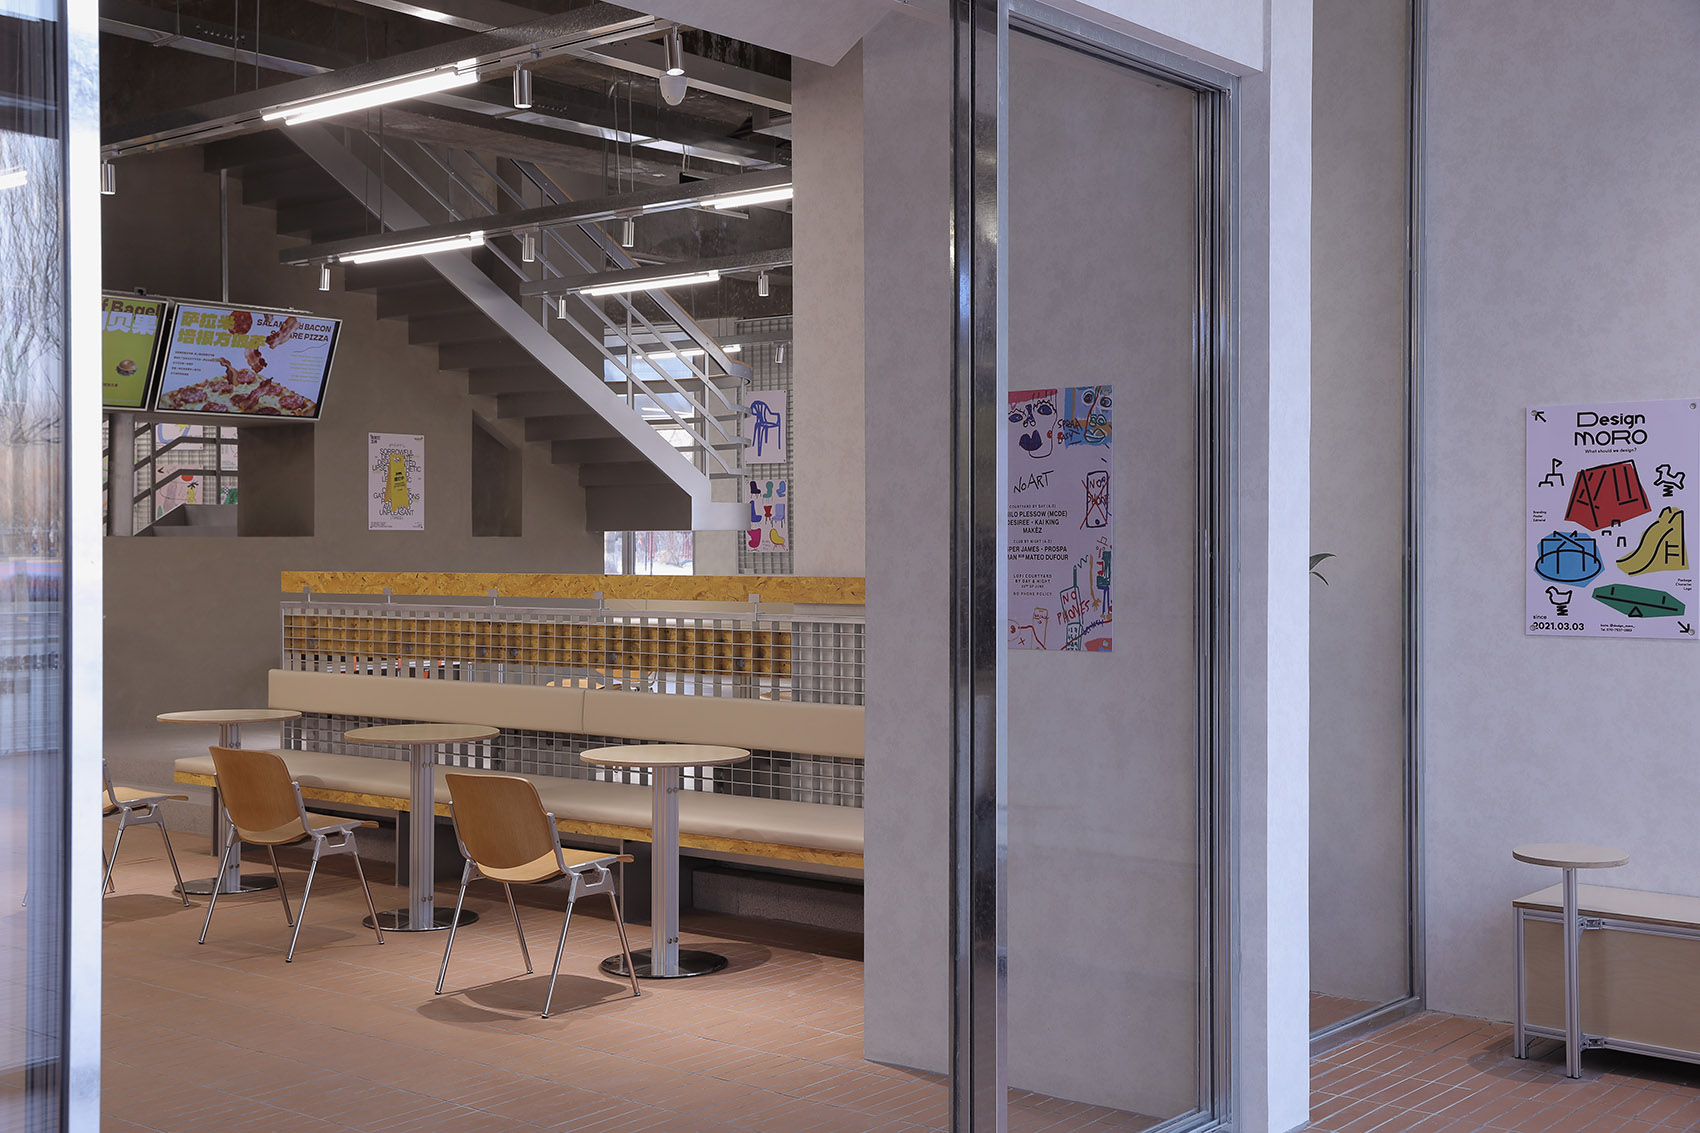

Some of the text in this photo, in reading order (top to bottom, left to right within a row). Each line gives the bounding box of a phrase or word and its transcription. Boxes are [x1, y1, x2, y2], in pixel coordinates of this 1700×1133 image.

[111, 300, 161, 320] Bagel
[180, 311, 236, 330] 萨拉米
[304, 324, 332, 333] BACON
[304, 333, 329, 342] PIZZA
[1577, 411, 1646, 429] Design
[1062, 591, 1077, 604] NO
[1056, 600, 1090, 625] PHONES
[1532, 621, 1585, 631] 2021.03.03
